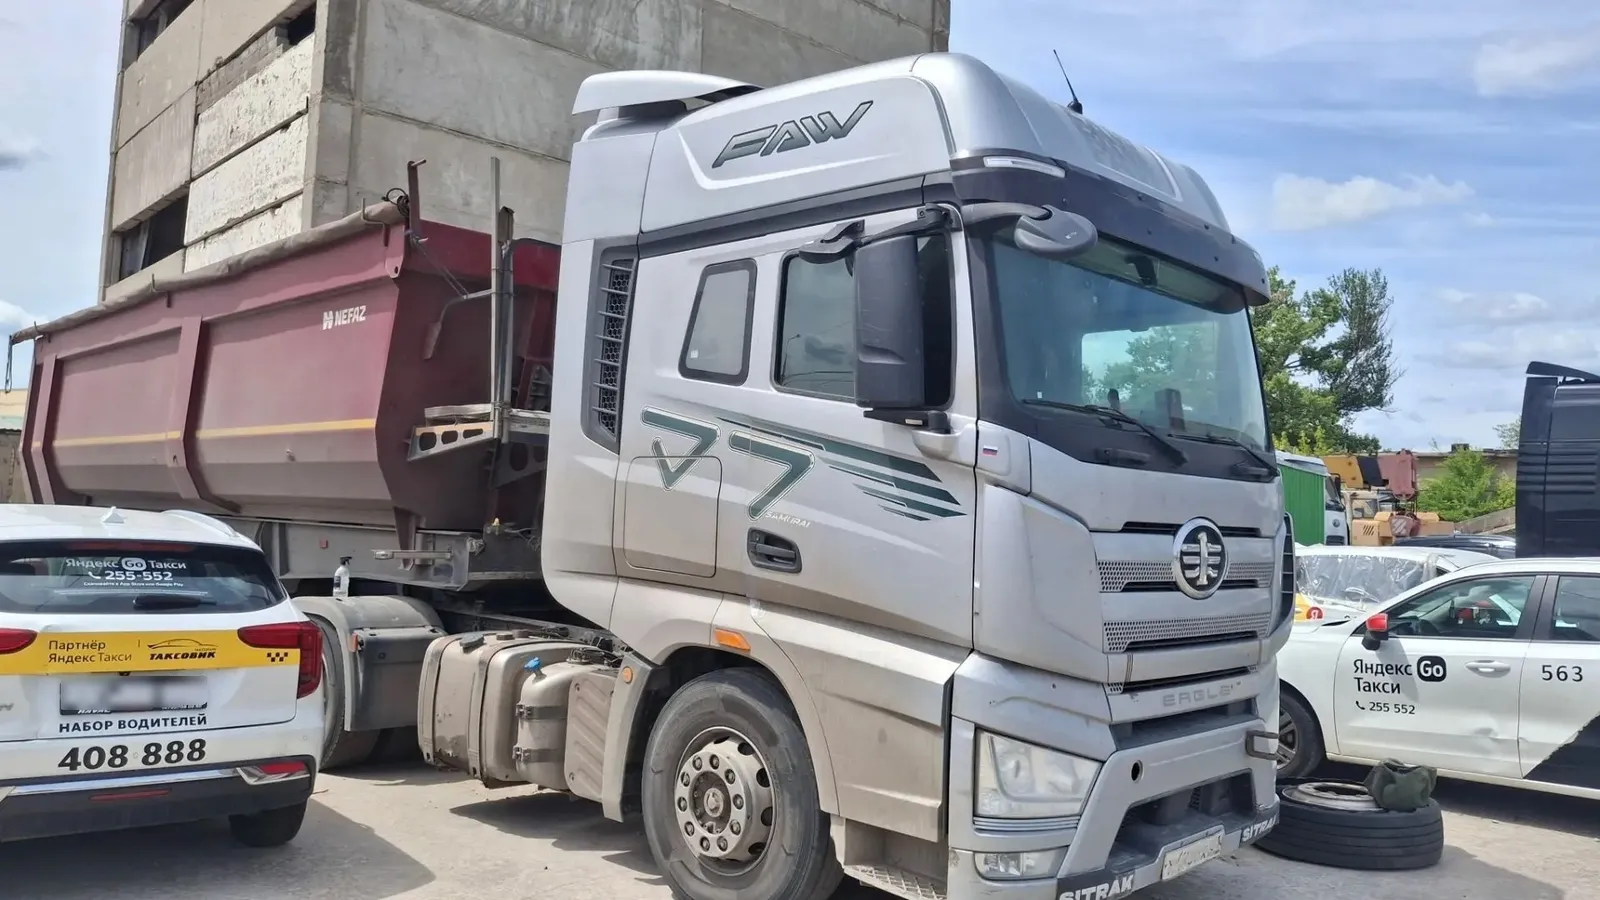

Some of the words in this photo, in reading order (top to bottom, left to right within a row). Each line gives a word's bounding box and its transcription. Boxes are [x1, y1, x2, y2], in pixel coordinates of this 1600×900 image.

[711, 100, 874, 168] FAW
[334, 305, 367, 326] NEFAZ
[65, 558, 119, 568] Яндекс
[148, 560, 187, 569] Такси
[104, 570, 174, 580] 255-552
[48, 639, 106, 652] Партнёр
[48, 653, 96, 664] Яндекс
[99, 652, 133, 663] Такси
[150, 651, 216, 661] ТАКСОВИК
[1353, 659, 1413, 677] Яндекс
[1419, 660, 1444, 677] Go
[1541, 664, 1583, 682] 563
[1354, 677, 1401, 695] Такси
[1162, 684, 1231, 707] EAGLE
[1369, 701, 1390, 713] 255
[1393, 703, 1416, 715] 552
[59, 720, 114, 733] НАБОР
[117, 713, 207, 730] ВОДИТЕЛЕЙ
[58, 745, 129, 771] 408
[141, 738, 206, 766] 888
[1059, 874, 1134, 900] SITRAK
